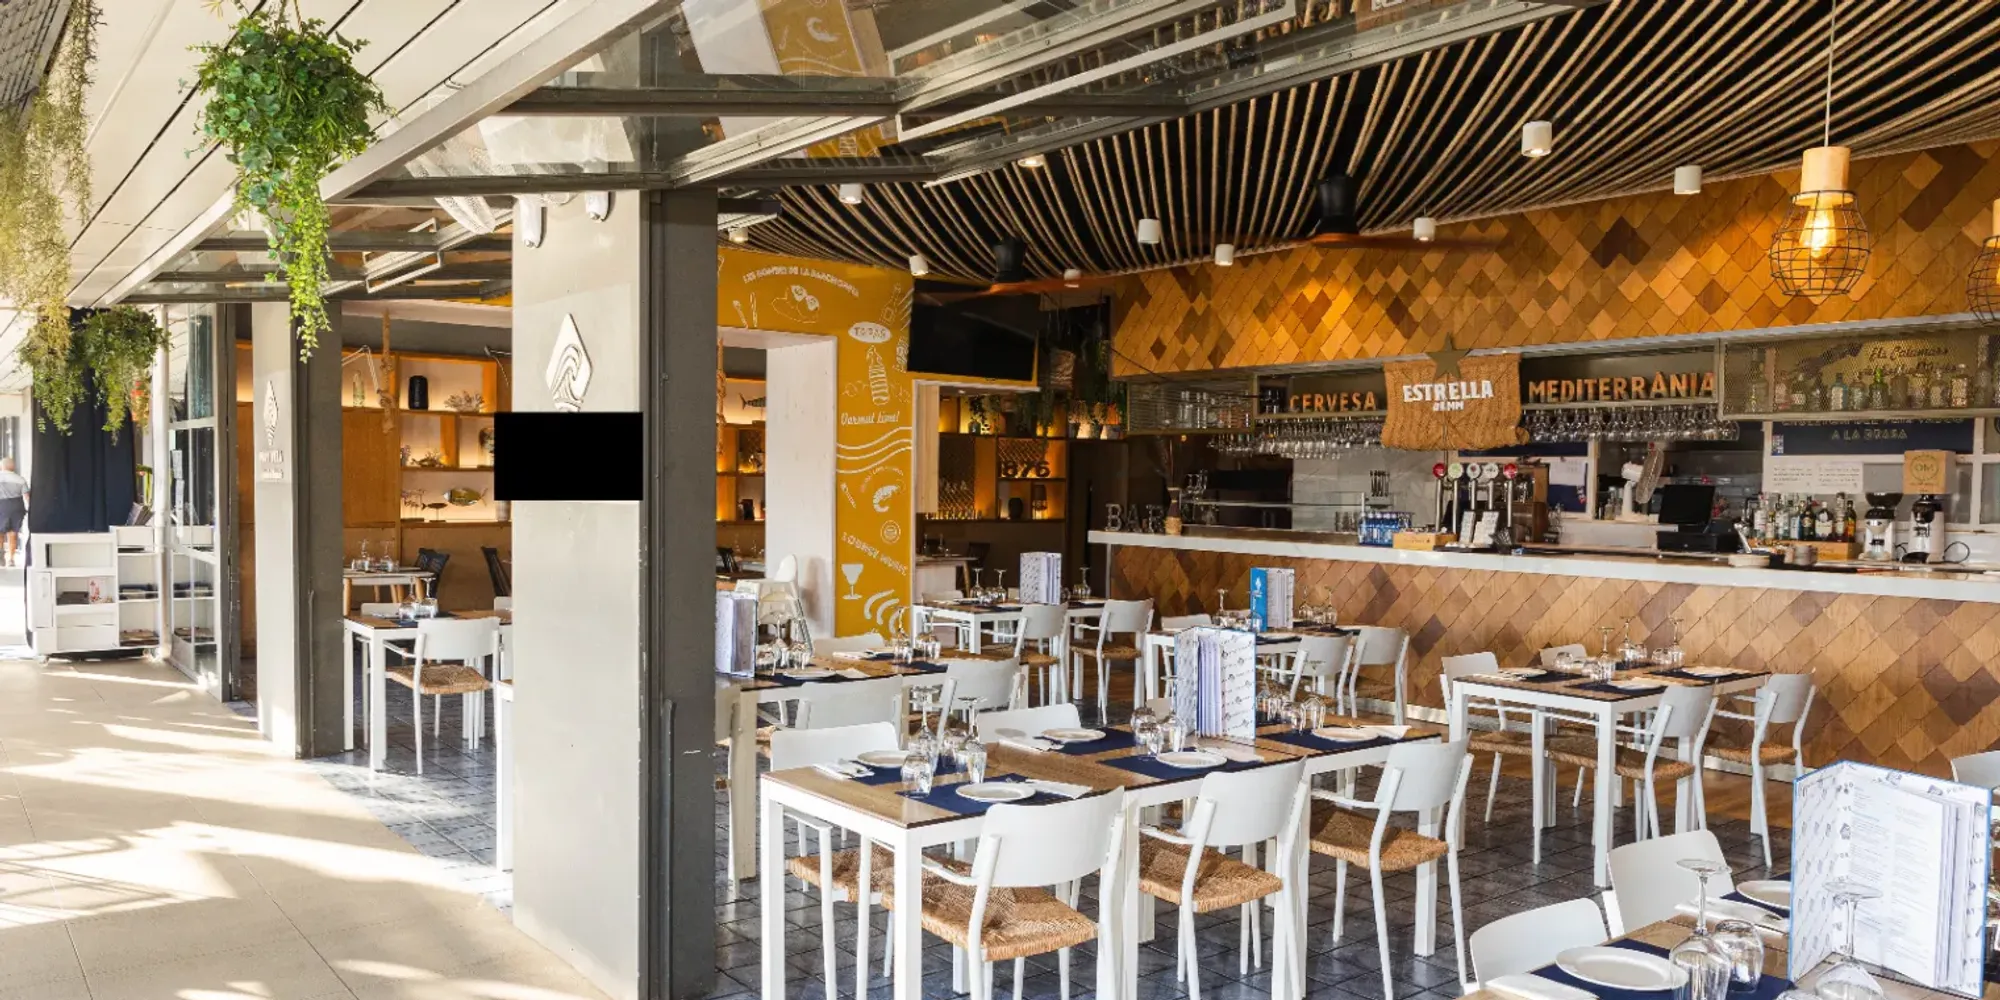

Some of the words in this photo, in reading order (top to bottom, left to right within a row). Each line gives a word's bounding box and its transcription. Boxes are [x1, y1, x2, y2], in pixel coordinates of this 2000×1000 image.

[854, 326, 886, 341] TAPAS
[1288, 391, 1377, 412] CERVESA
[1403, 380, 1494, 403] ESTRELLA
[1105, 503, 1165, 533] BAR
